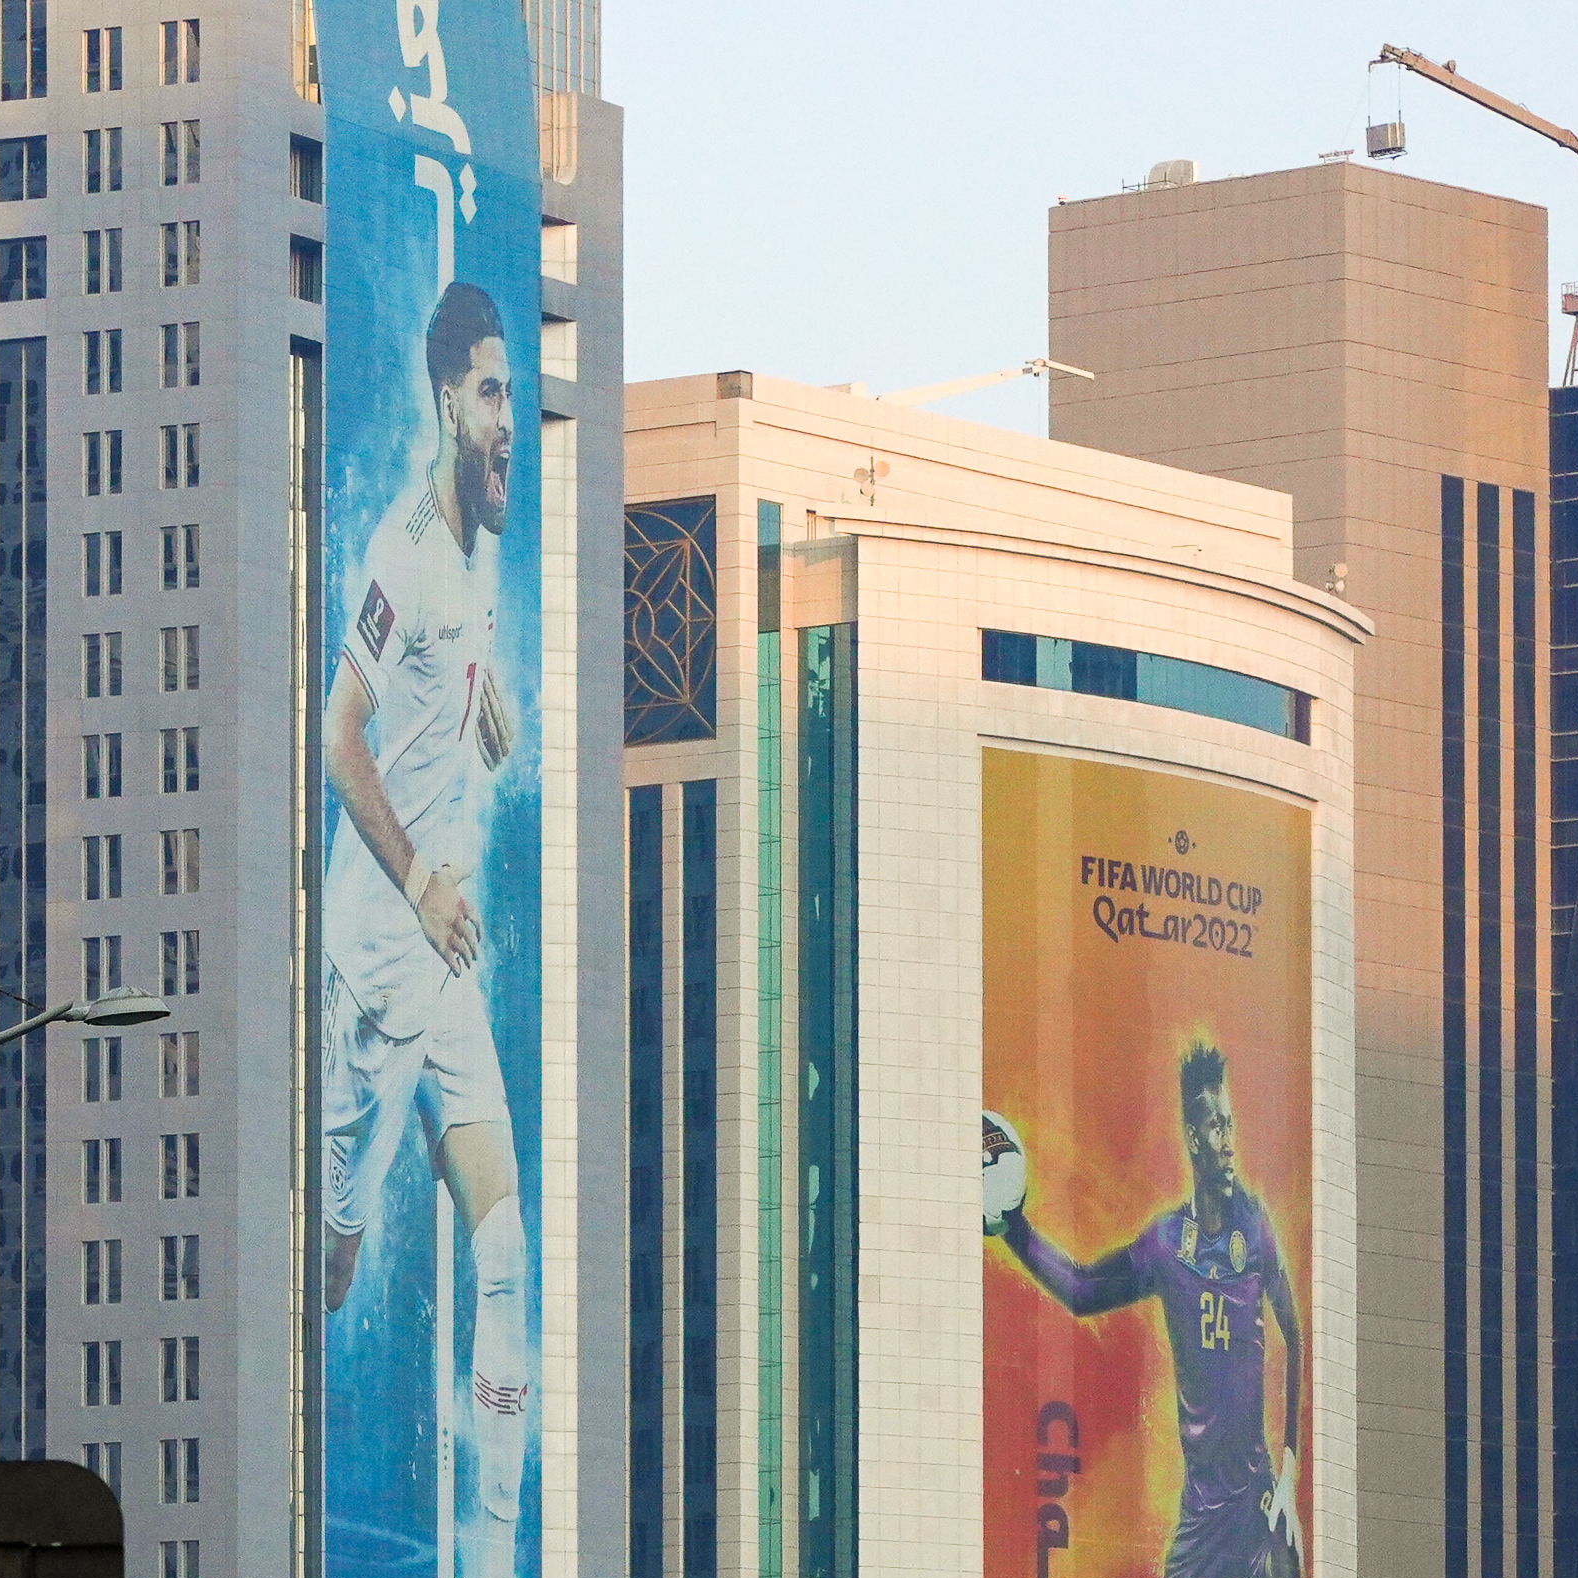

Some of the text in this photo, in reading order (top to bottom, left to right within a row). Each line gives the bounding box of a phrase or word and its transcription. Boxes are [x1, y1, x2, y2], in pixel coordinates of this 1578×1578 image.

[1081, 855, 1262, 915] FIFA WORLD CUP
[1093, 895, 1253, 958] Qatar2022
[1200, 1291, 1230, 1351] 24
